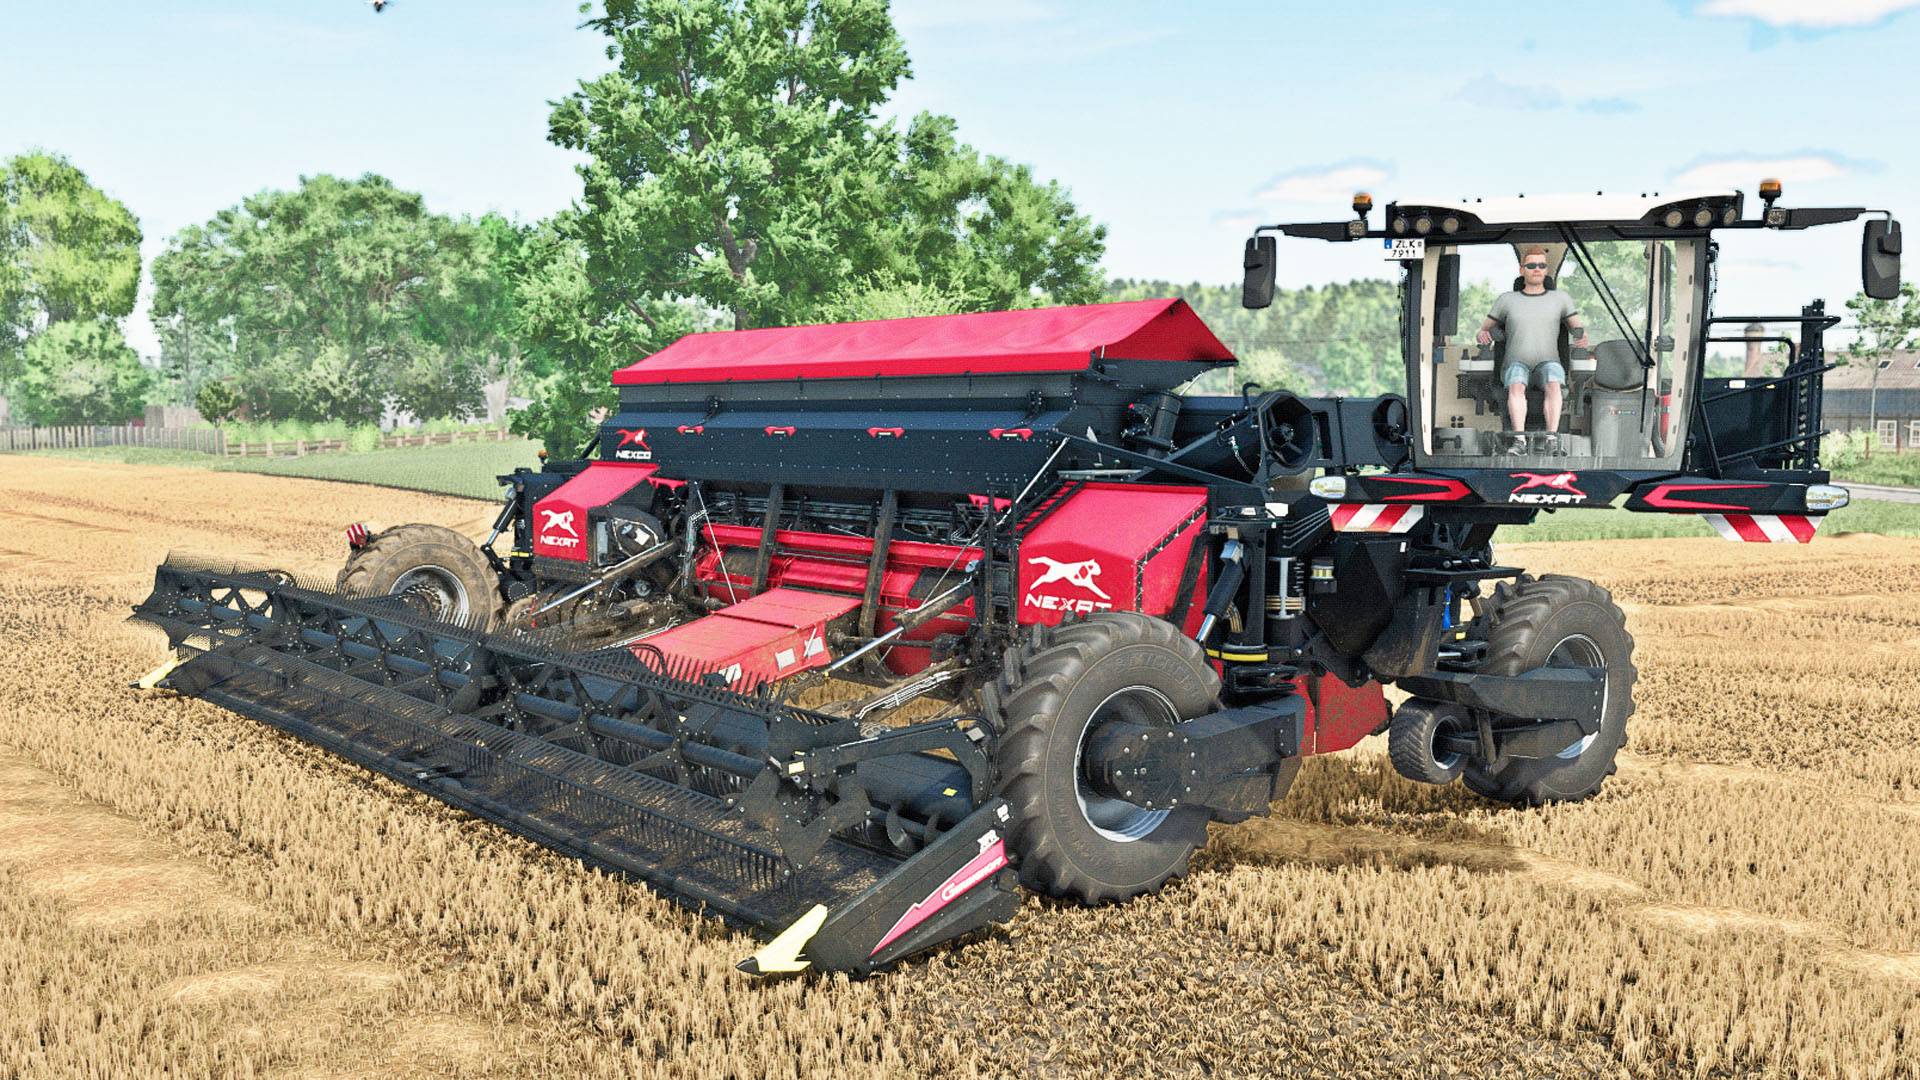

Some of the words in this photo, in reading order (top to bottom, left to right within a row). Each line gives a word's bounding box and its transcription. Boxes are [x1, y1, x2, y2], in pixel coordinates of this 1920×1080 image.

[1395, 240, 1416, 248] ZLK
[1391, 249, 1416, 258] 7911
[1508, 493, 1587, 504] NEXAT
[540, 535, 579, 548] NEXAT
[1025, 593, 1112, 612] NEXAT
